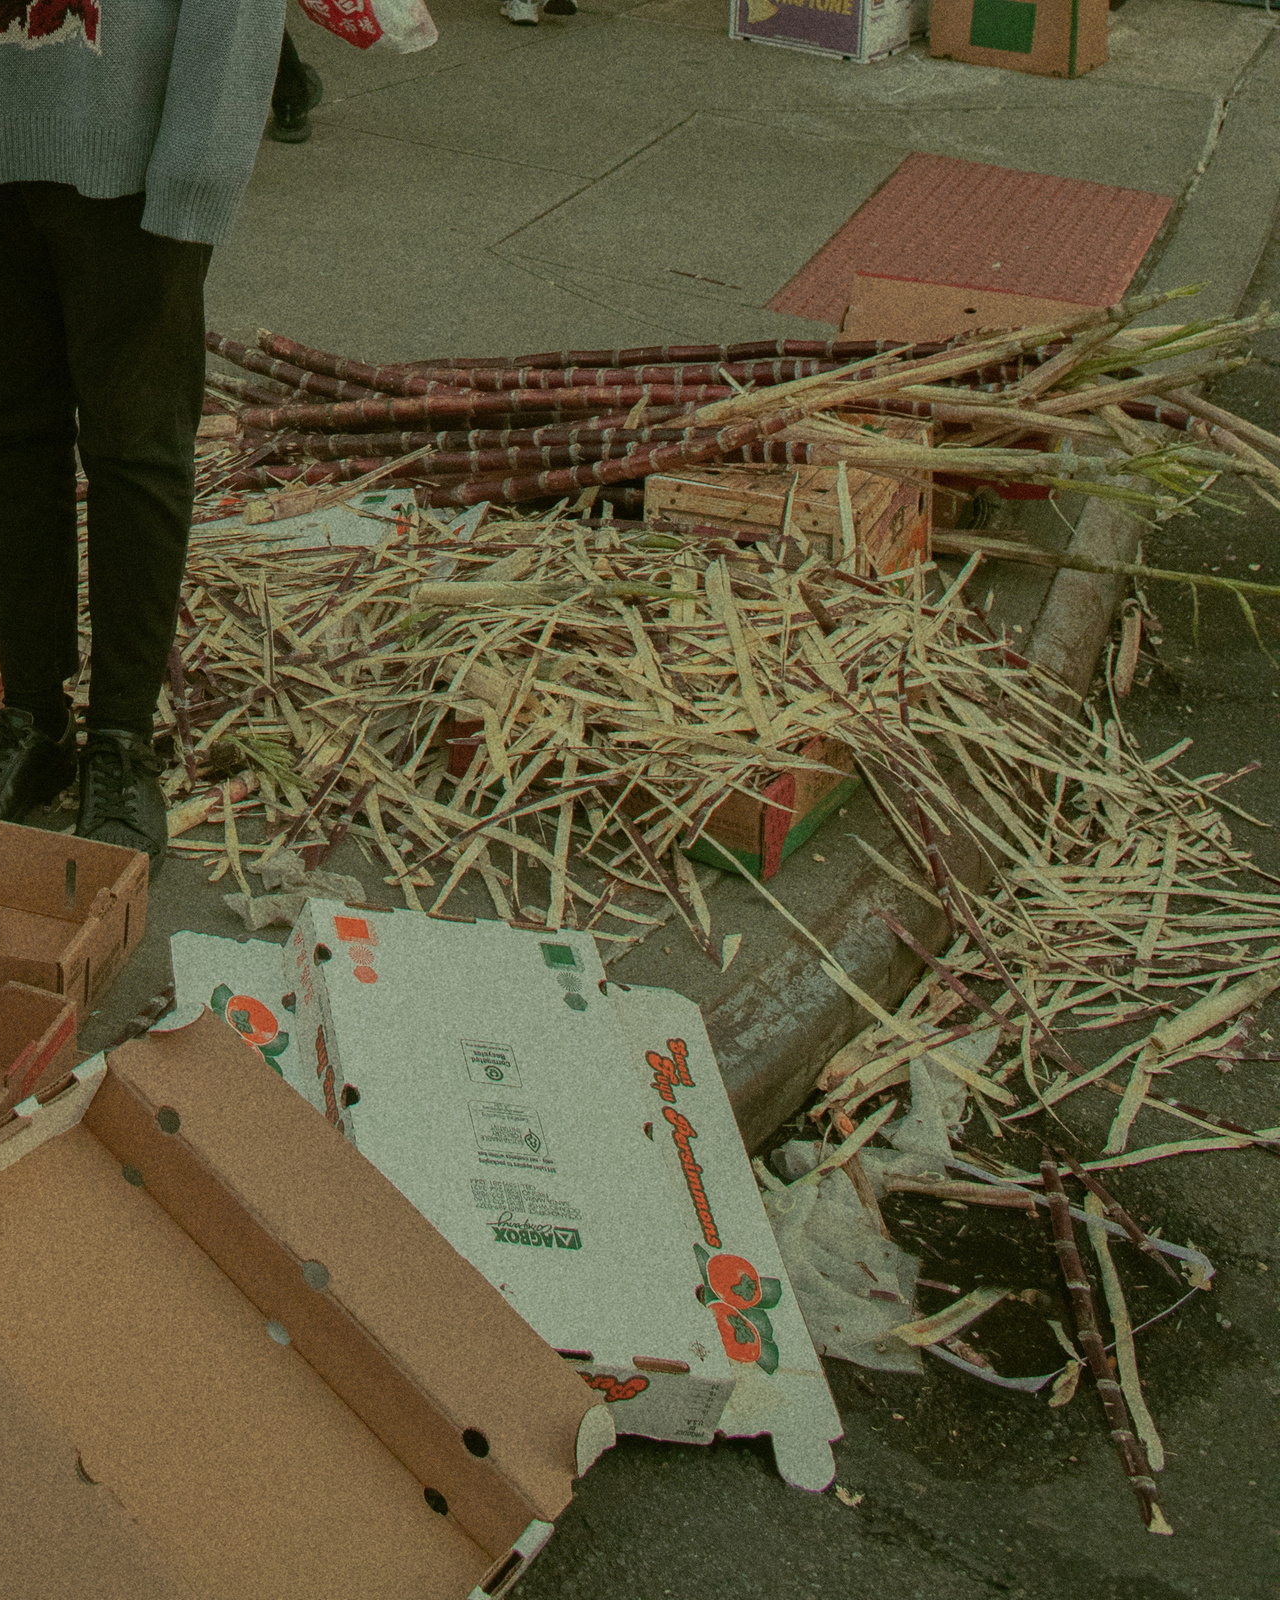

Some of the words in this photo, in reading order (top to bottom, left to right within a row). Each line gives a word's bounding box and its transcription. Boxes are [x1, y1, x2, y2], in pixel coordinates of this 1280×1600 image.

[471, 1055, 511, 1068] Corrugated
[661, 1105, 722, 1250] Persimmons
[487, 1210, 552, 1234] Company
[494, 1226, 554, 1249] AGBOX
